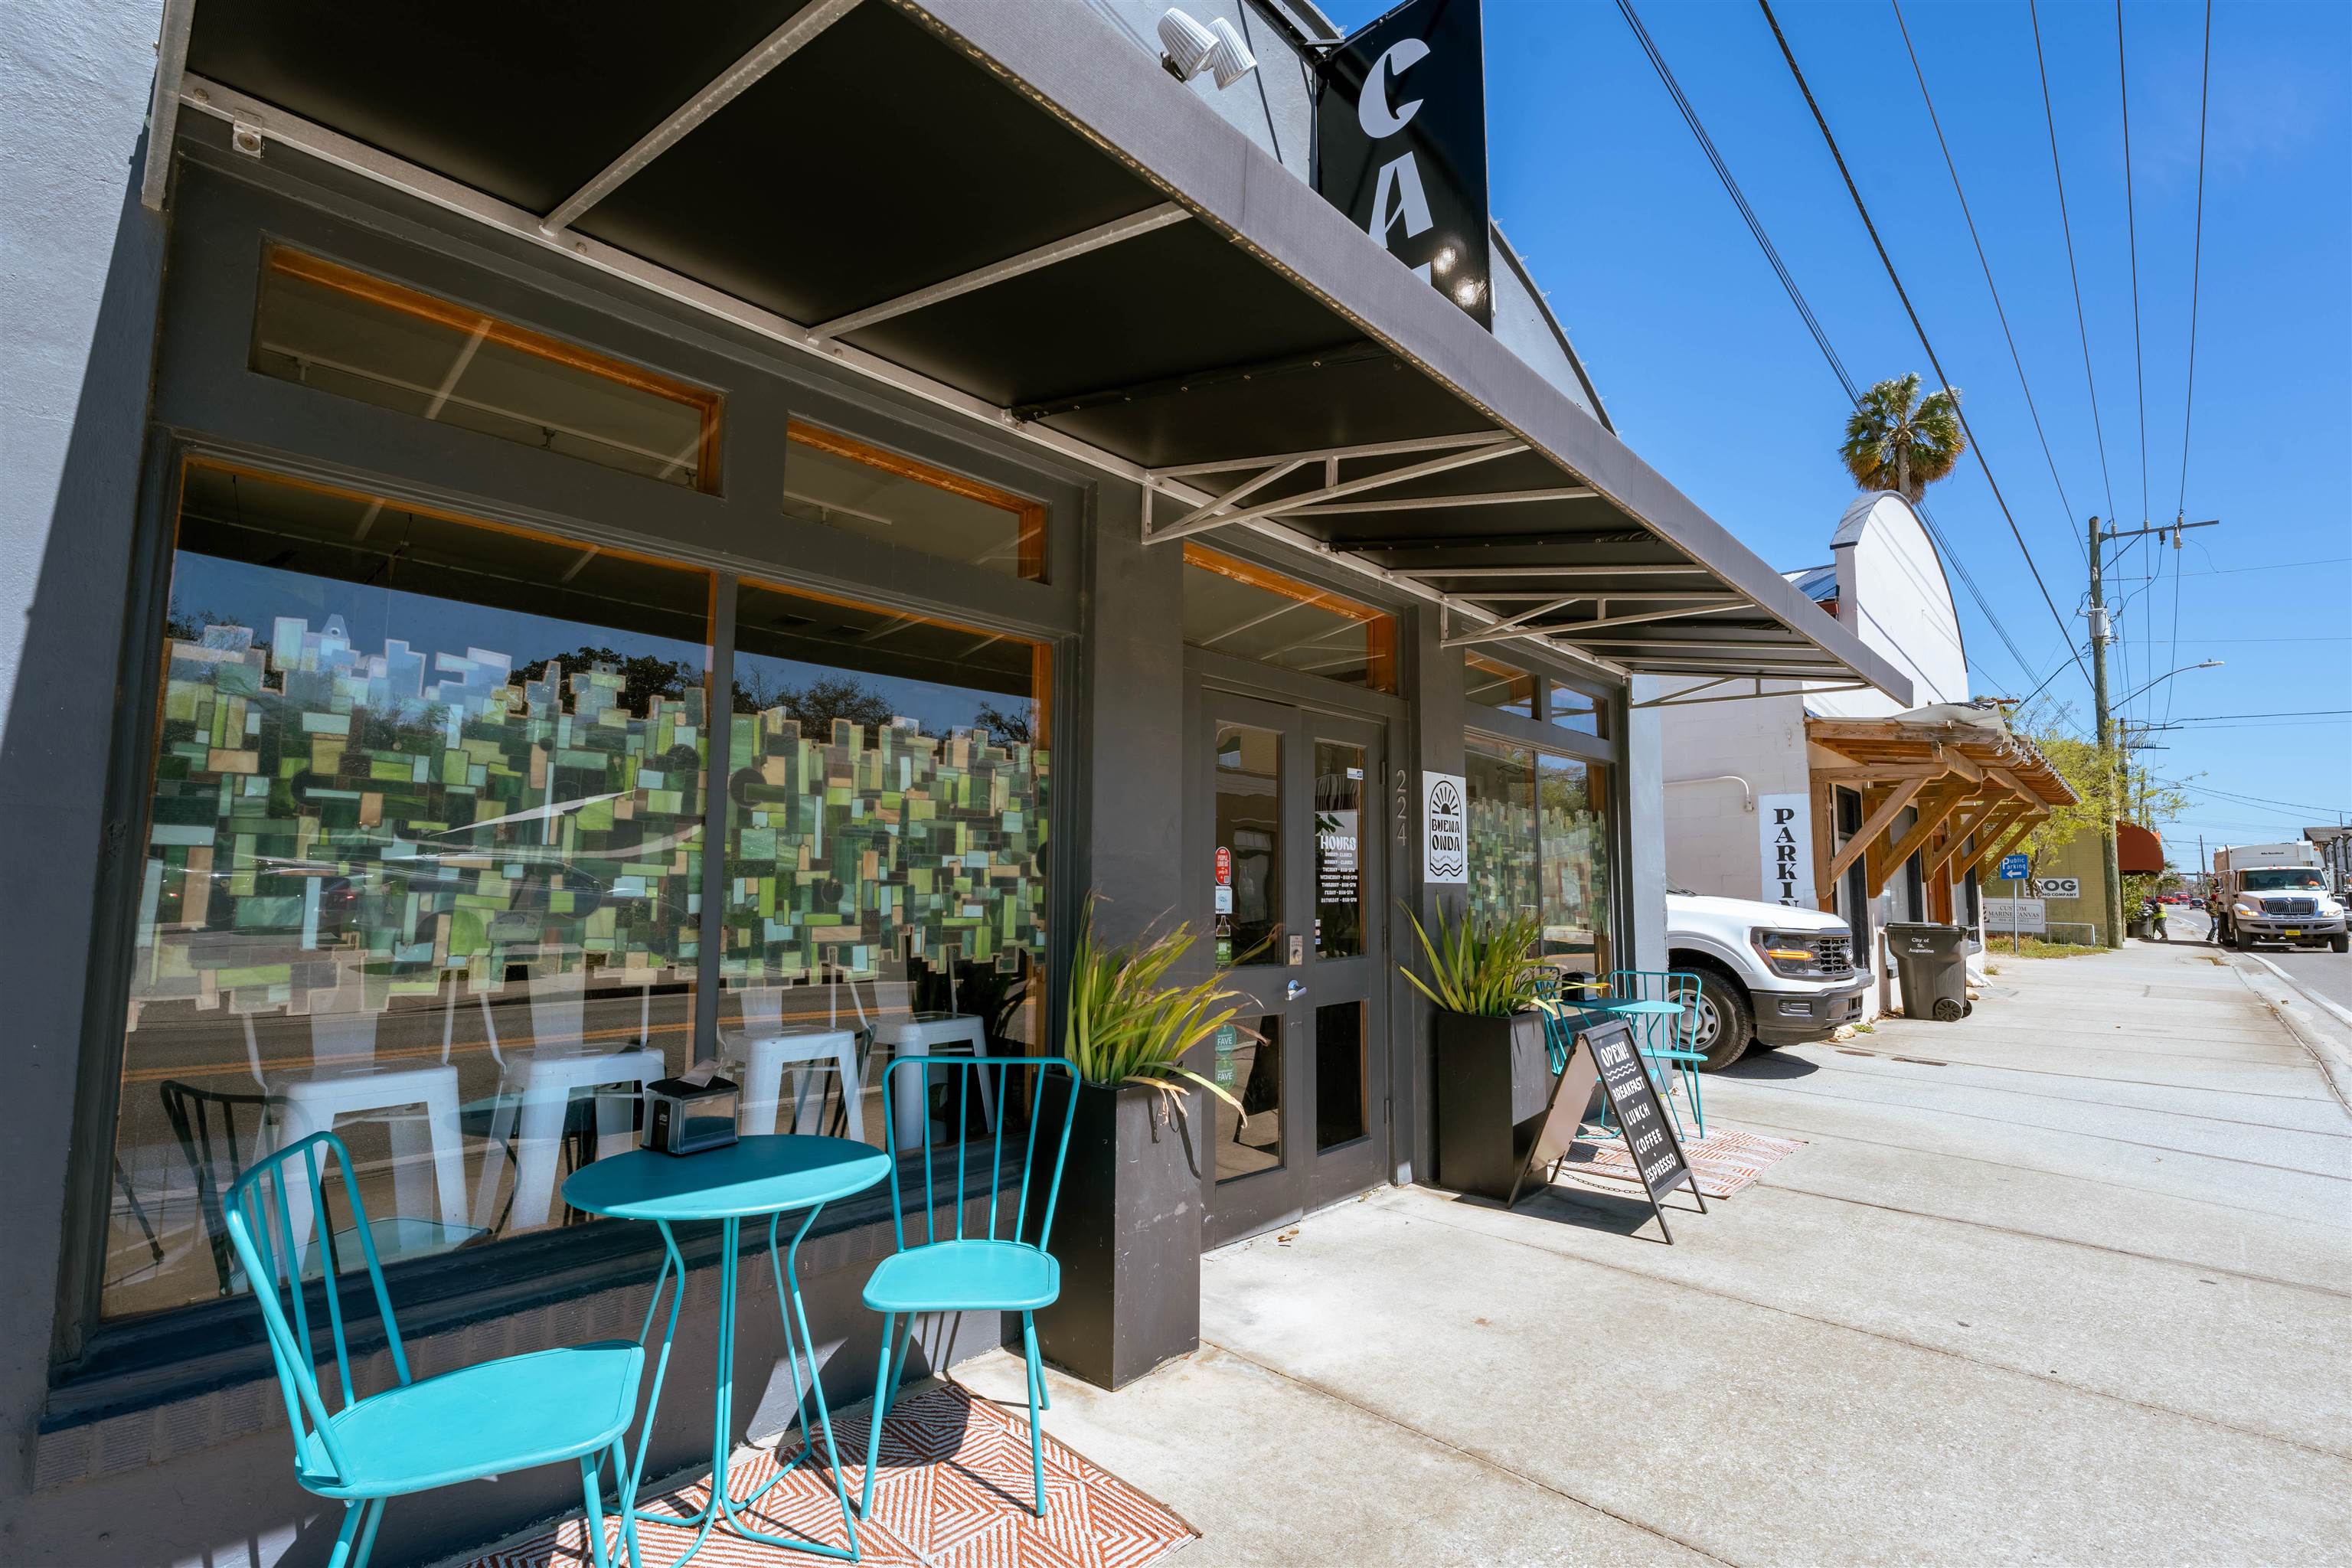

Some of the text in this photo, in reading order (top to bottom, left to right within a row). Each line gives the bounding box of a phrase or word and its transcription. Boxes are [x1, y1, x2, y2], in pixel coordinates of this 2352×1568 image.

[1358, 38, 1433, 287] CA
[1396, 769, 1407, 846] 224
[1432, 818, 1460, 834] BUENA
[1320, 835, 1357, 851] HOURS
[1432, 834, 1460, 851] ONDA
[2002, 858, 2025, 866] Public
[1217, 1037, 1233, 1046] FAVE
[1600, 1041, 1629, 1067] OPEN!
[1217, 1072, 1233, 1081] FAVE
[1625, 1102, 1651, 1126] LUNCH
[1635, 1129, 1663, 1155] COFFEE
[1645, 1152, 1677, 1184] ESPRESSO
